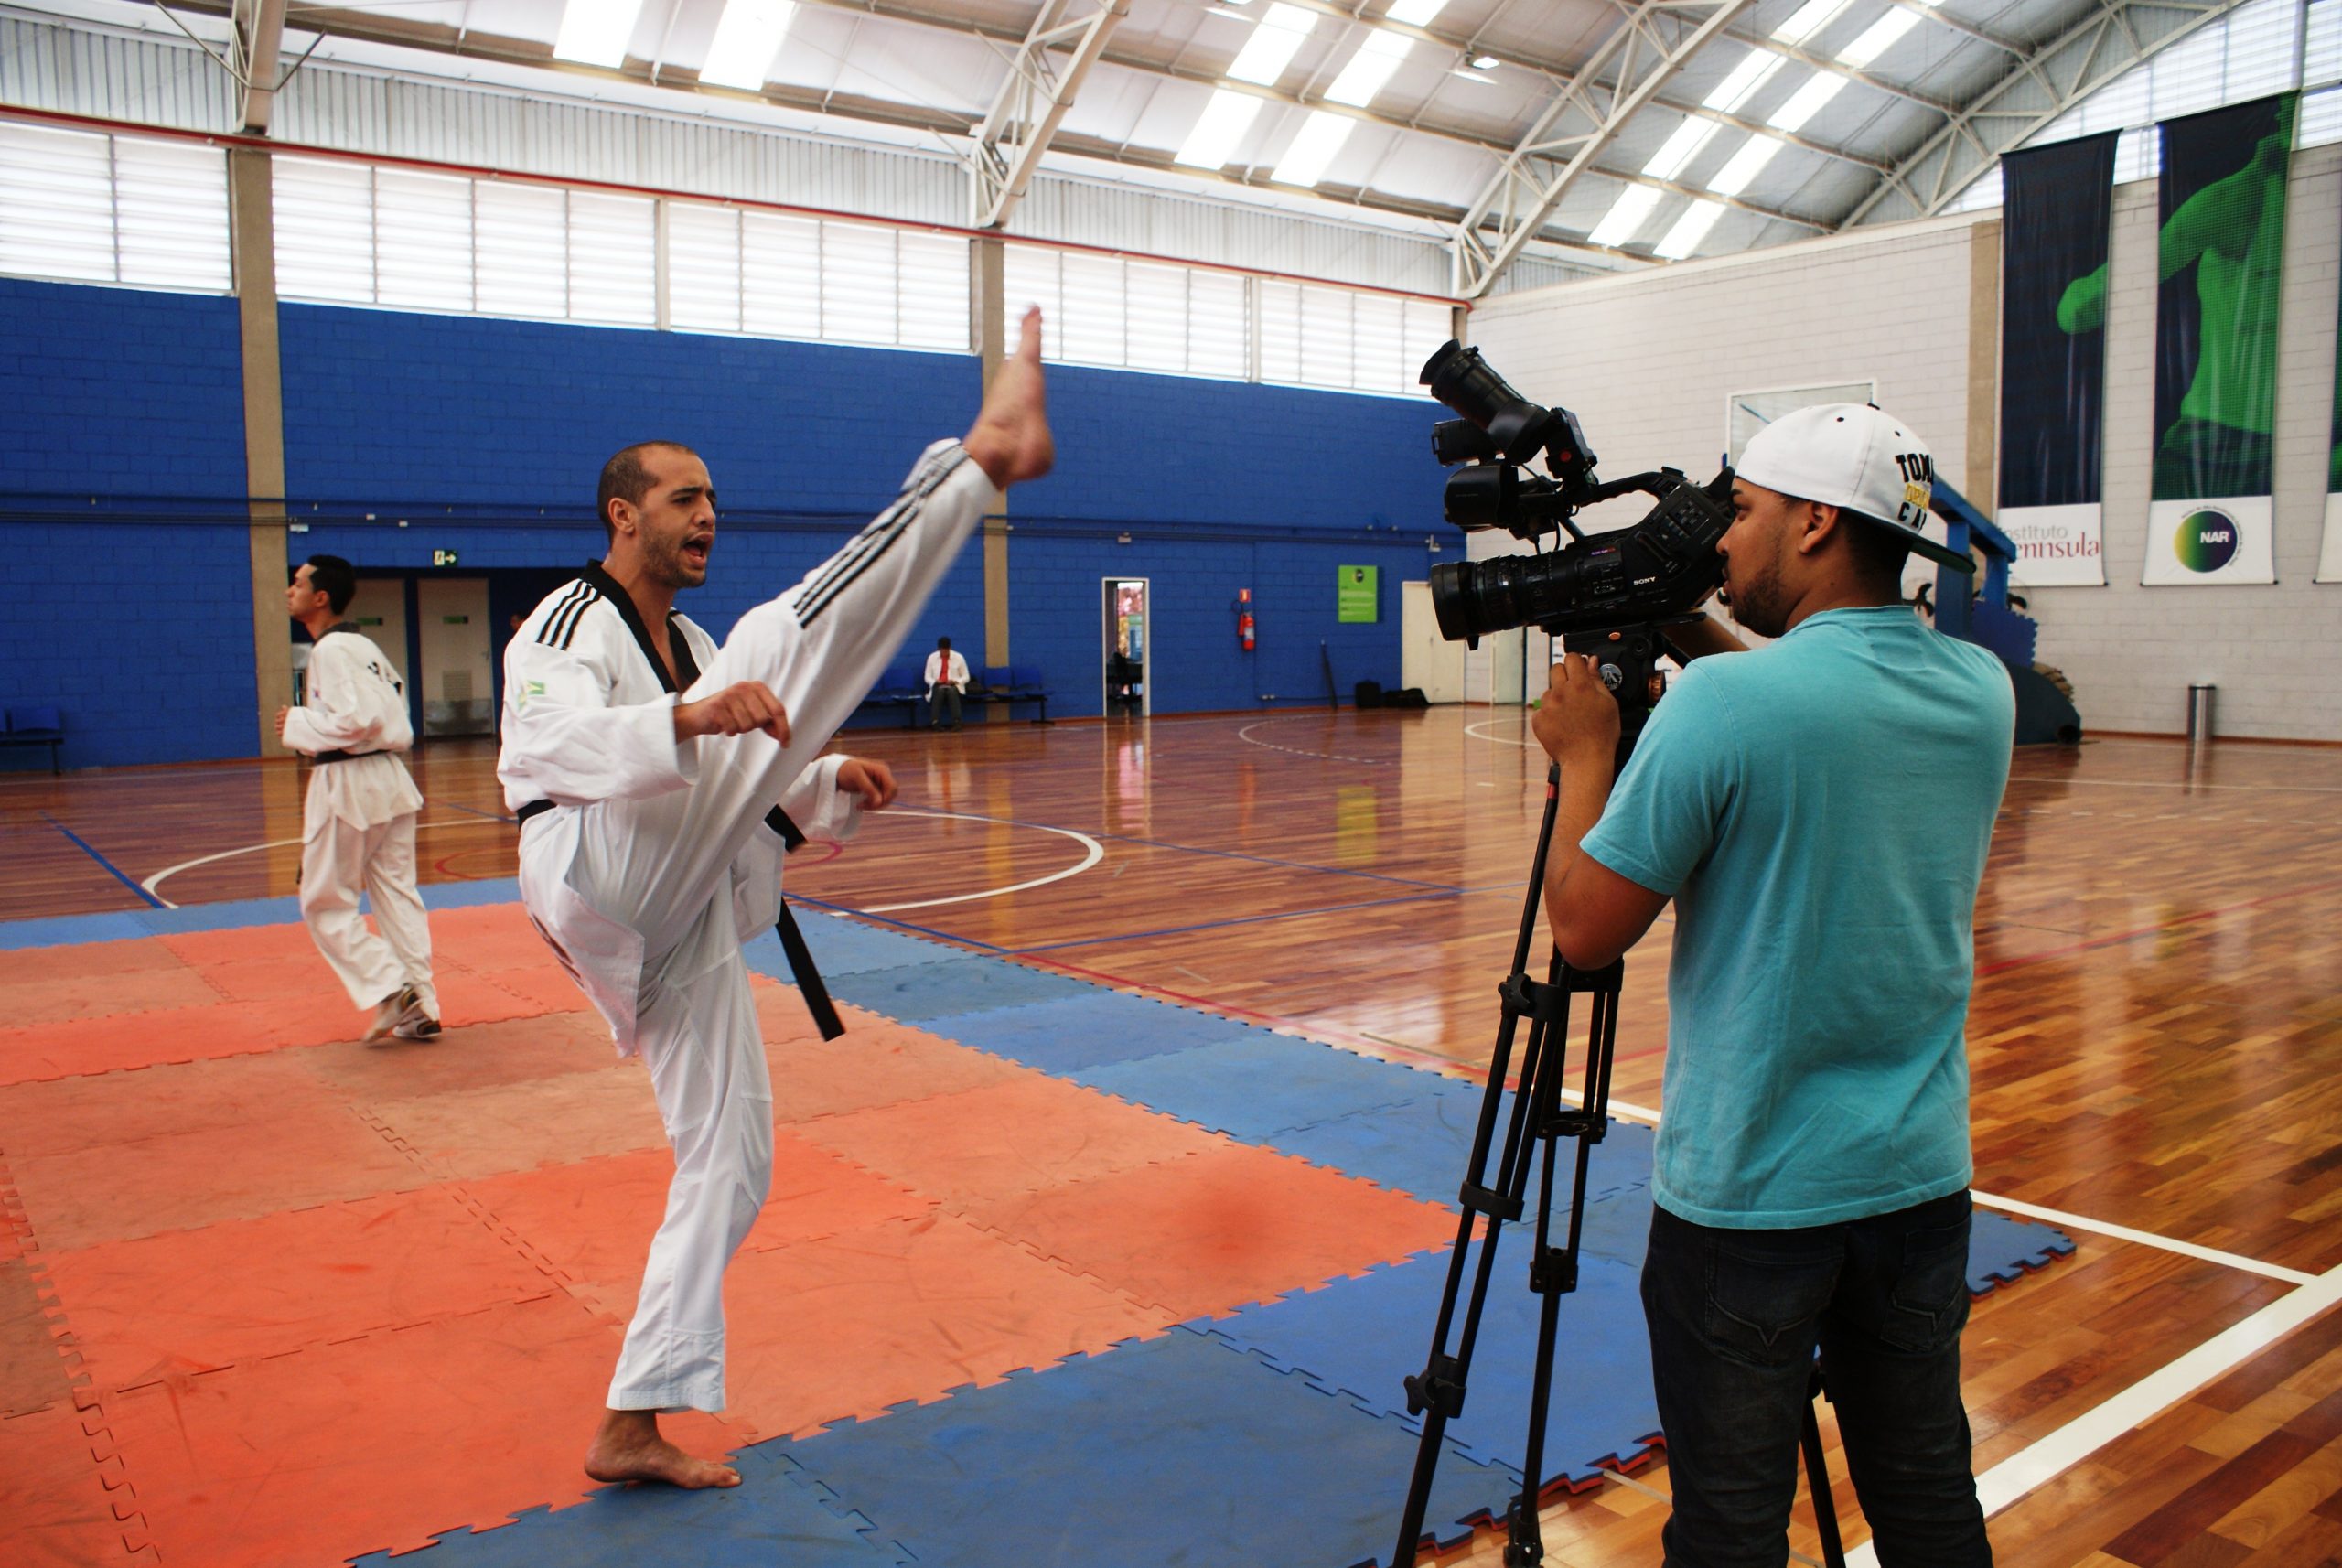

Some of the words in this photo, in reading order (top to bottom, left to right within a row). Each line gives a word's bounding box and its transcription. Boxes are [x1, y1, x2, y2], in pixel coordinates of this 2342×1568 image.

[2199, 531, 2230, 544] NAR
[2016, 531, 2100, 559] eninsula
[1633, 576, 1656, 585] SONY
